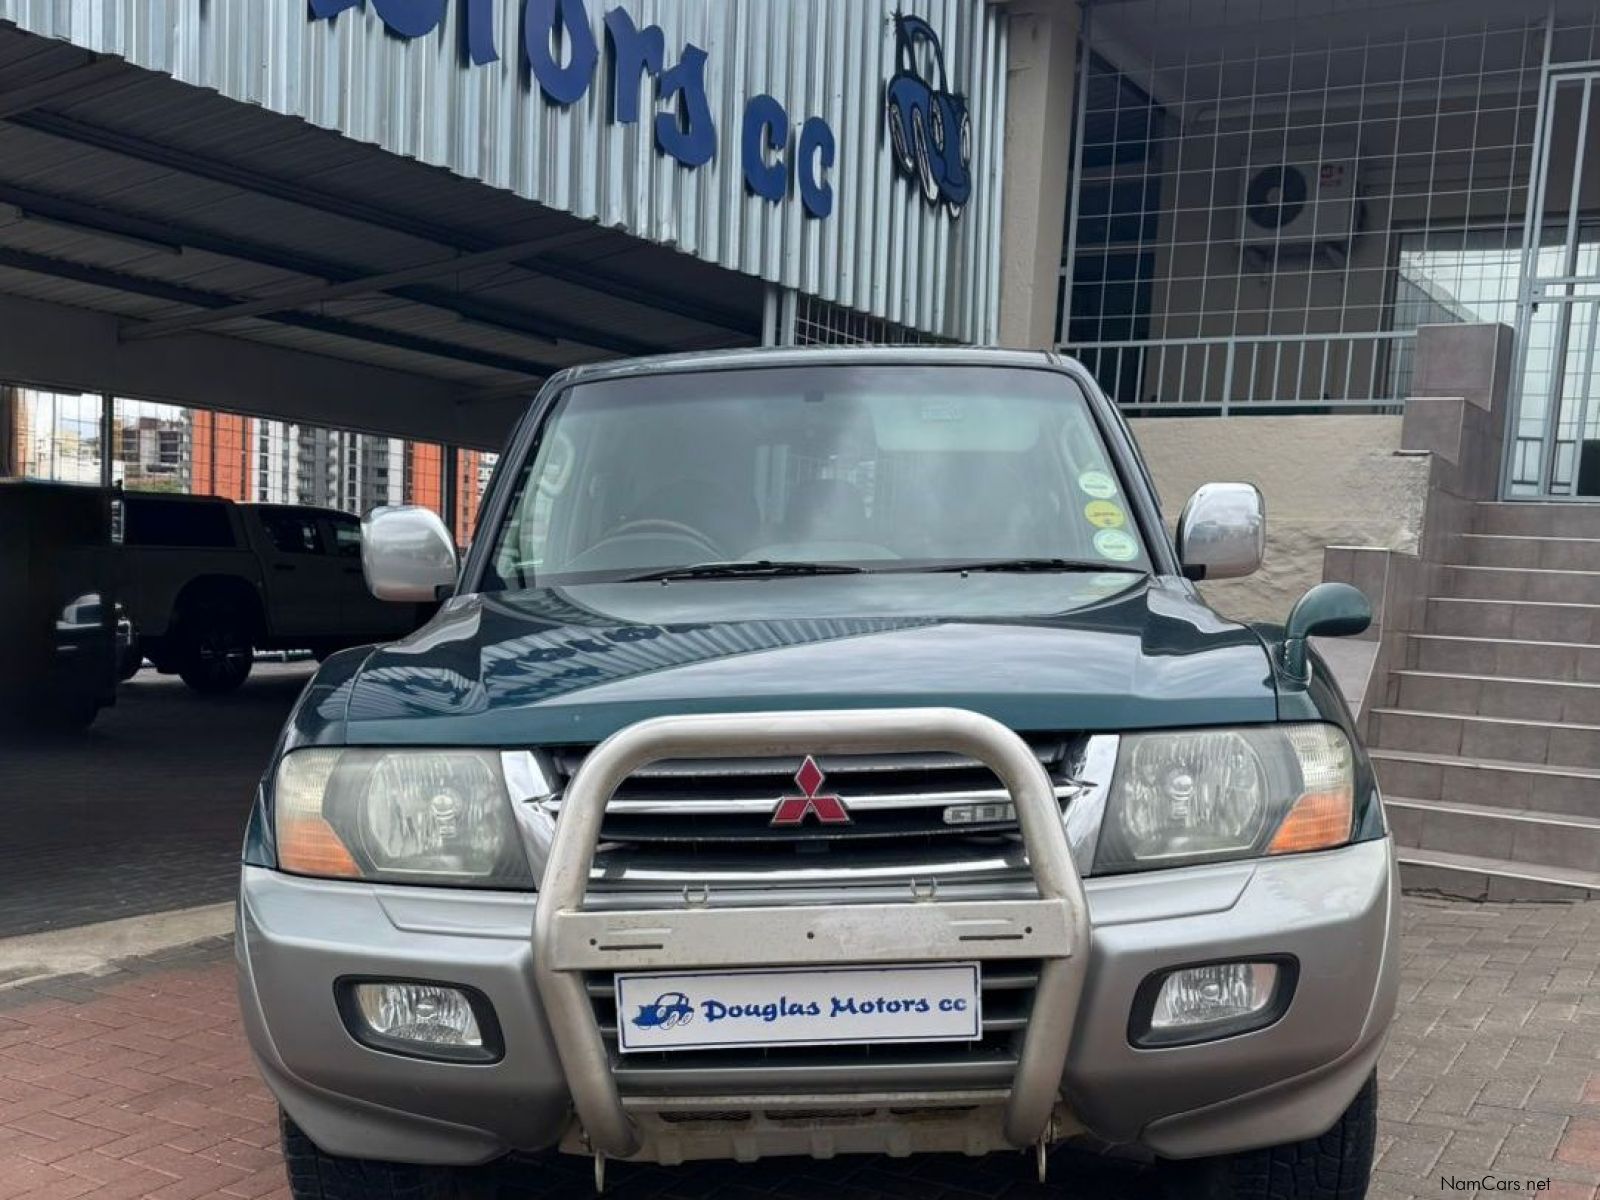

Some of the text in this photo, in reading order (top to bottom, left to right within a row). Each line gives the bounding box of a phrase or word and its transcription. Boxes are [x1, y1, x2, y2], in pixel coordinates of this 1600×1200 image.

[741, 94, 835, 219] cc
[701, 996, 967, 1023] Douglas Motors cc
